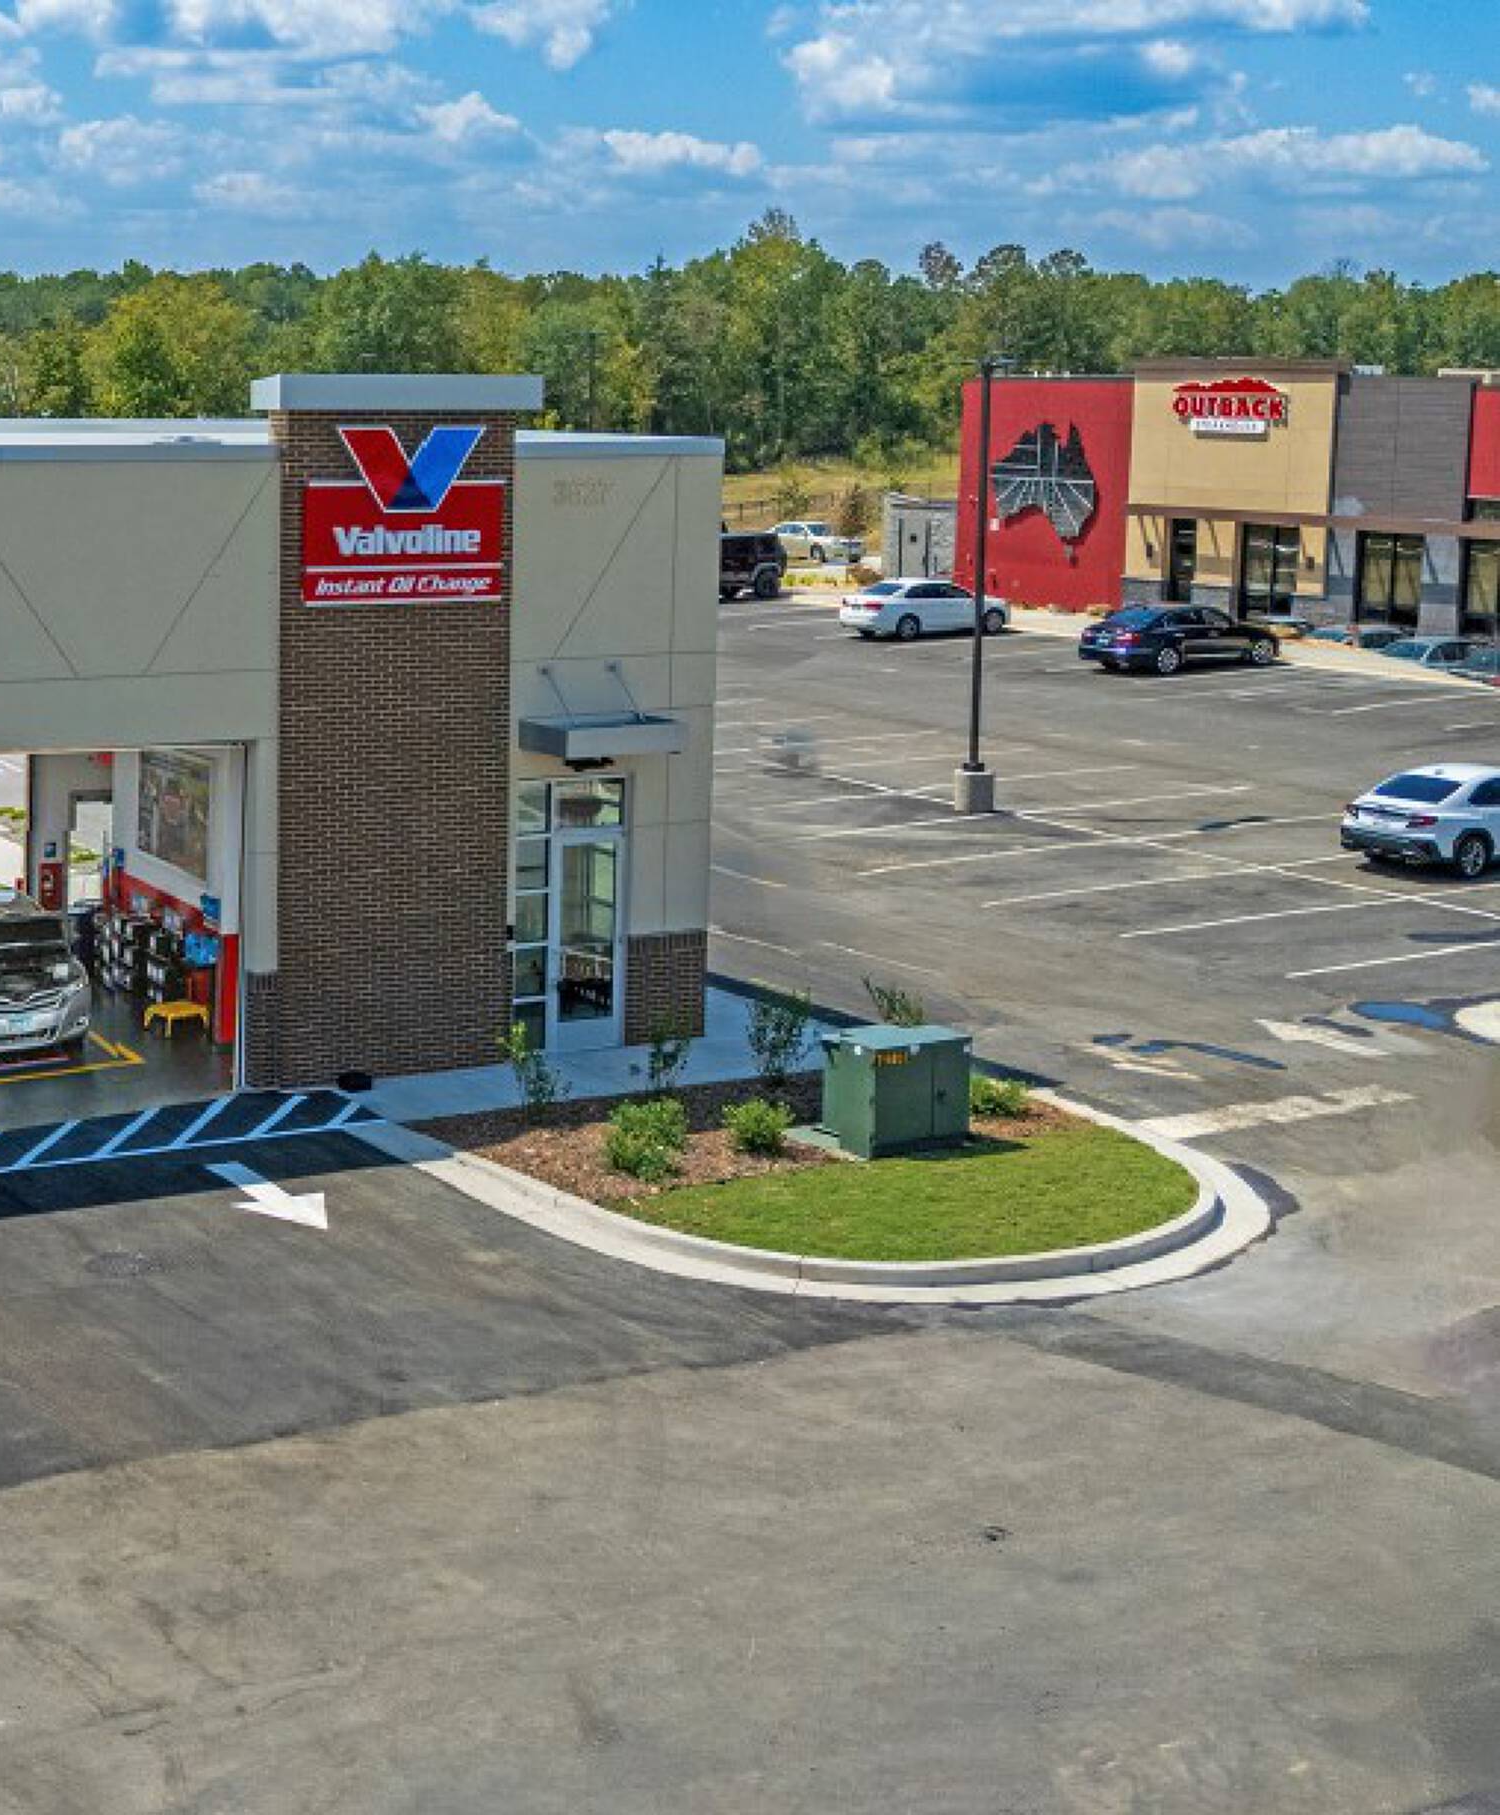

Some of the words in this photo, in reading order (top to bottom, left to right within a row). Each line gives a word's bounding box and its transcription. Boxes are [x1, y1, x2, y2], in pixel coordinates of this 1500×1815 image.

[1172, 397, 1284, 419] OUTBACK
[333, 524, 482, 555] Valvoline
[315, 577, 386, 596] Instant
[387, 574, 417, 594] Oil
[418, 574, 493, 595] Change
